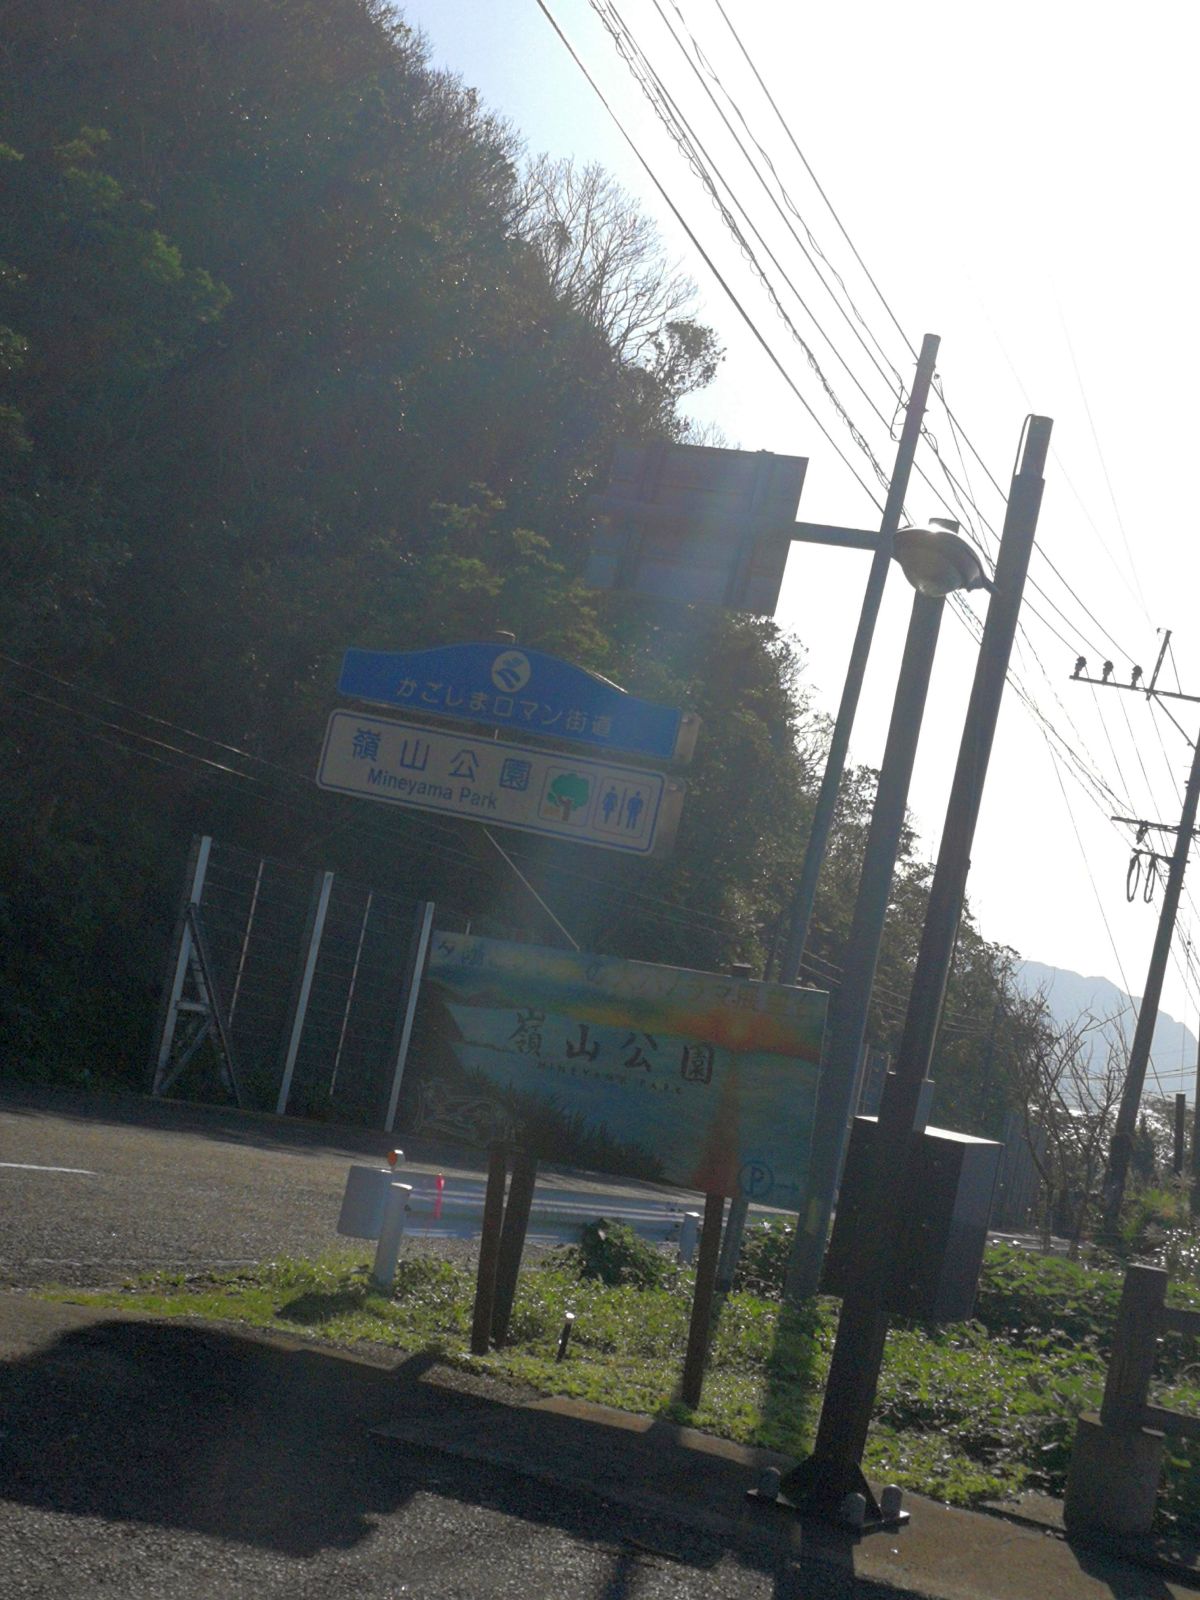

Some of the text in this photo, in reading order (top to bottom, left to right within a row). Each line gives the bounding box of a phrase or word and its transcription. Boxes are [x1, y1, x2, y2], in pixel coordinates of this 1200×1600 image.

[396, 677, 613, 738] かごしまロマン街道
[352, 727, 533, 792] 嶺山公園
[367, 768, 498, 810] Mineyama Park
[509, 1008, 714, 1085] 嶺山公園
